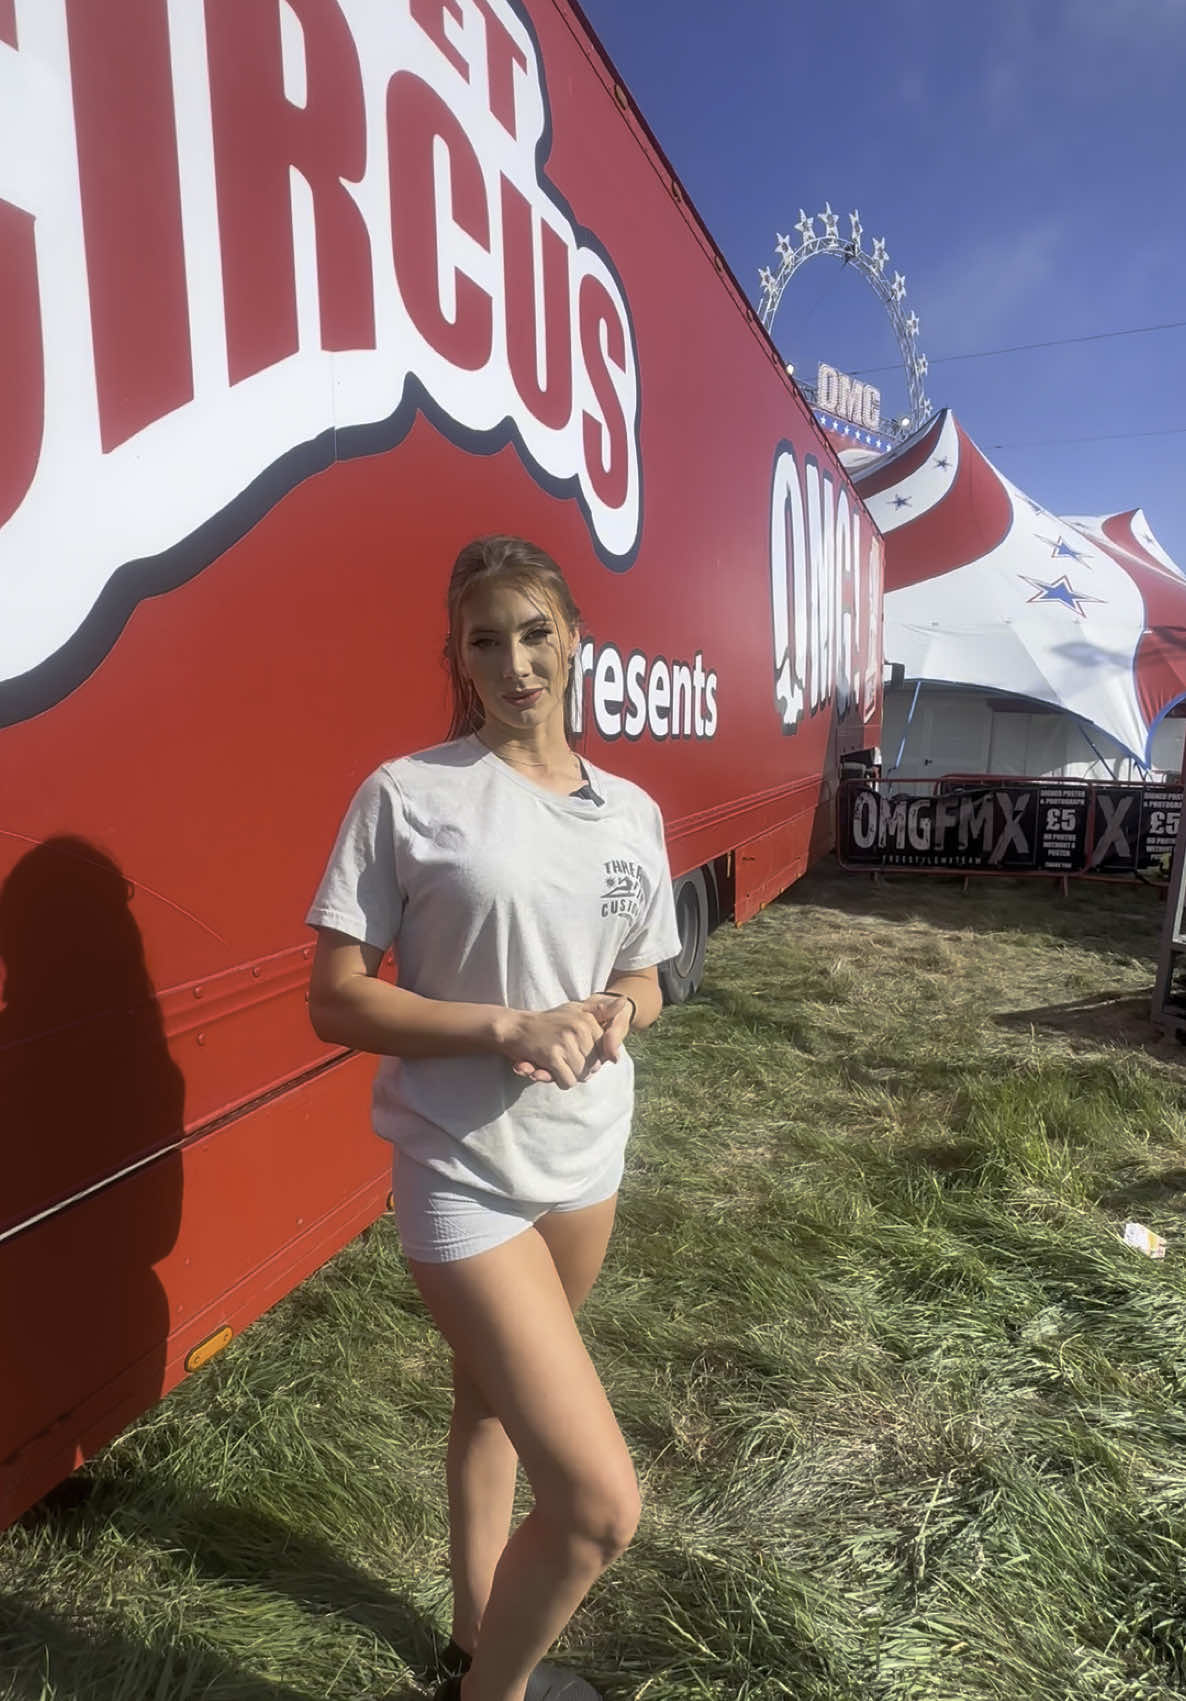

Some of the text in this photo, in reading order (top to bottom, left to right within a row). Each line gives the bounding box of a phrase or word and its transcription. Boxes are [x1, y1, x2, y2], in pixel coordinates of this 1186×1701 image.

[817, 363, 881, 433] OMG
[571, 642, 718, 736] resents
[1046, 808, 1076, 831] £5
[1149, 811, 1181, 834] £5
